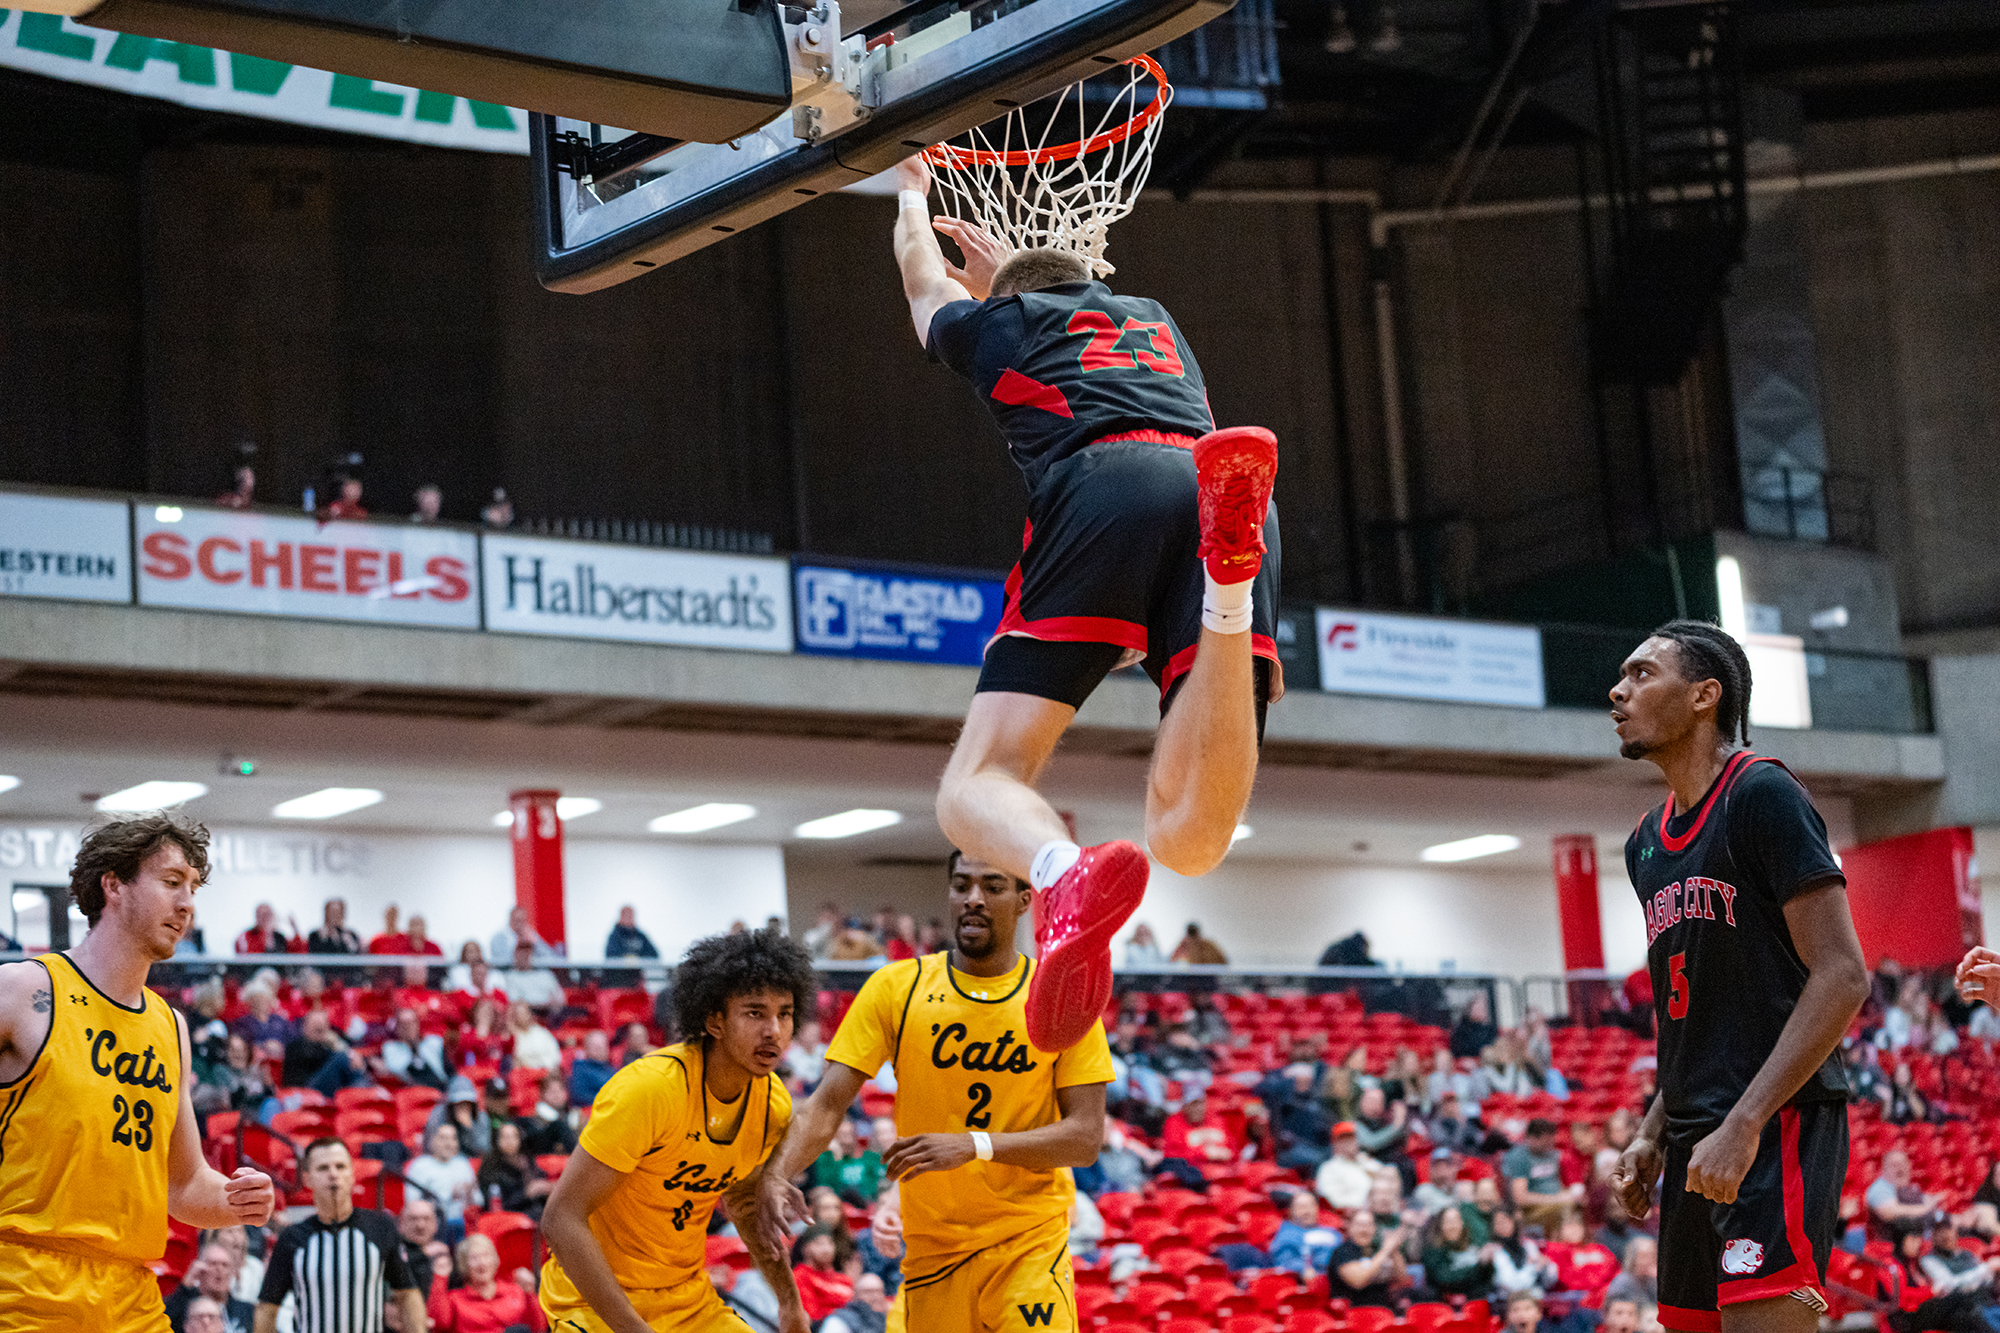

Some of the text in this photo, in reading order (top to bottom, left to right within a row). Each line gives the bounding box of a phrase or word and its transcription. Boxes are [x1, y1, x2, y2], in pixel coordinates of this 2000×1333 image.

[1065, 309, 1186, 380] 23
[142, 530, 471, 602] SCHEELS
[502, 554, 776, 632] Halberstadt's
[1646, 876, 1737, 948] AGIC CITY
[1668, 951, 1689, 1020] 5
[85, 1027, 172, 1094] 'Cats
[931, 1022, 1038, 1074] 'Cats
[112, 1094, 154, 1152] 23
[965, 1082, 992, 1129] 2
[1017, 1302, 1056, 1328] W
